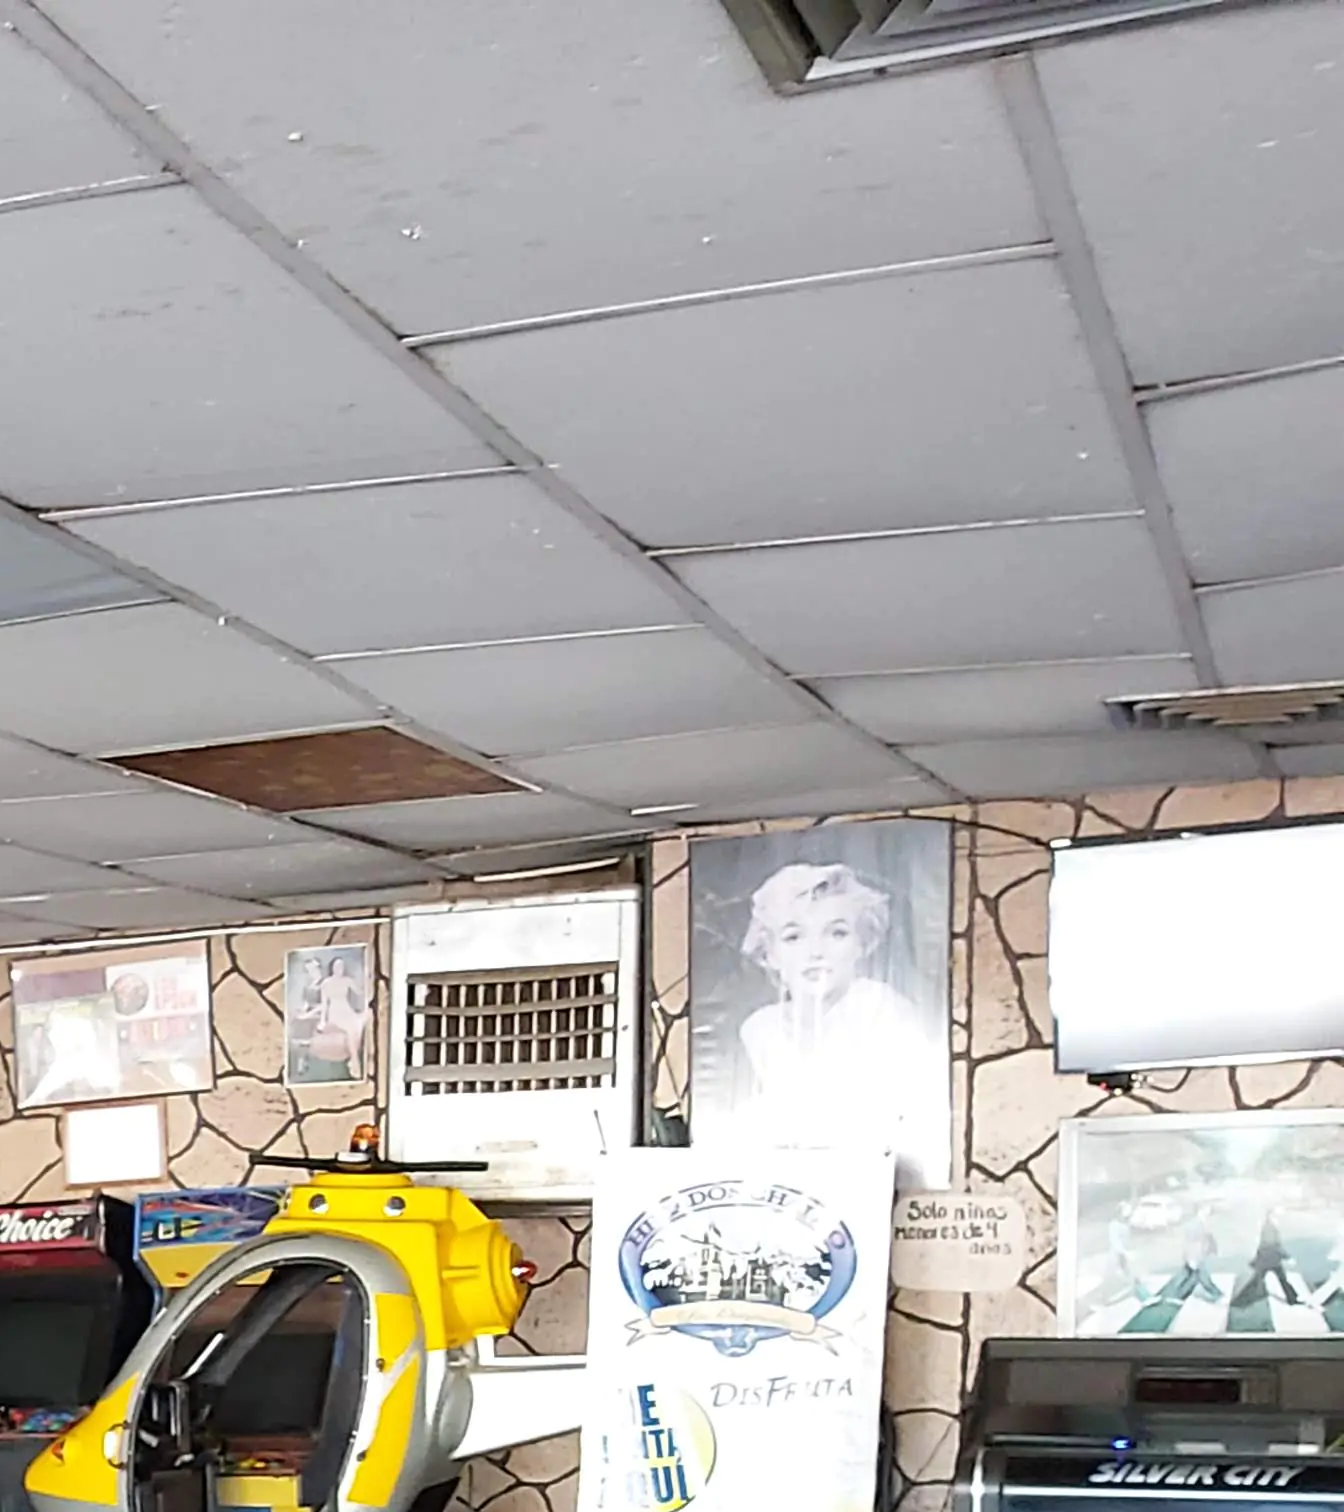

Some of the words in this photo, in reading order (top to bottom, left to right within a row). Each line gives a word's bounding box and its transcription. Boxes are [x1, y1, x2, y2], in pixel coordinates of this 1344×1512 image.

[907, 1201, 948, 1221] Solo
[1088, 1462, 1217, 1485] SILVER
[1223, 1465, 1307, 1487] CITY
